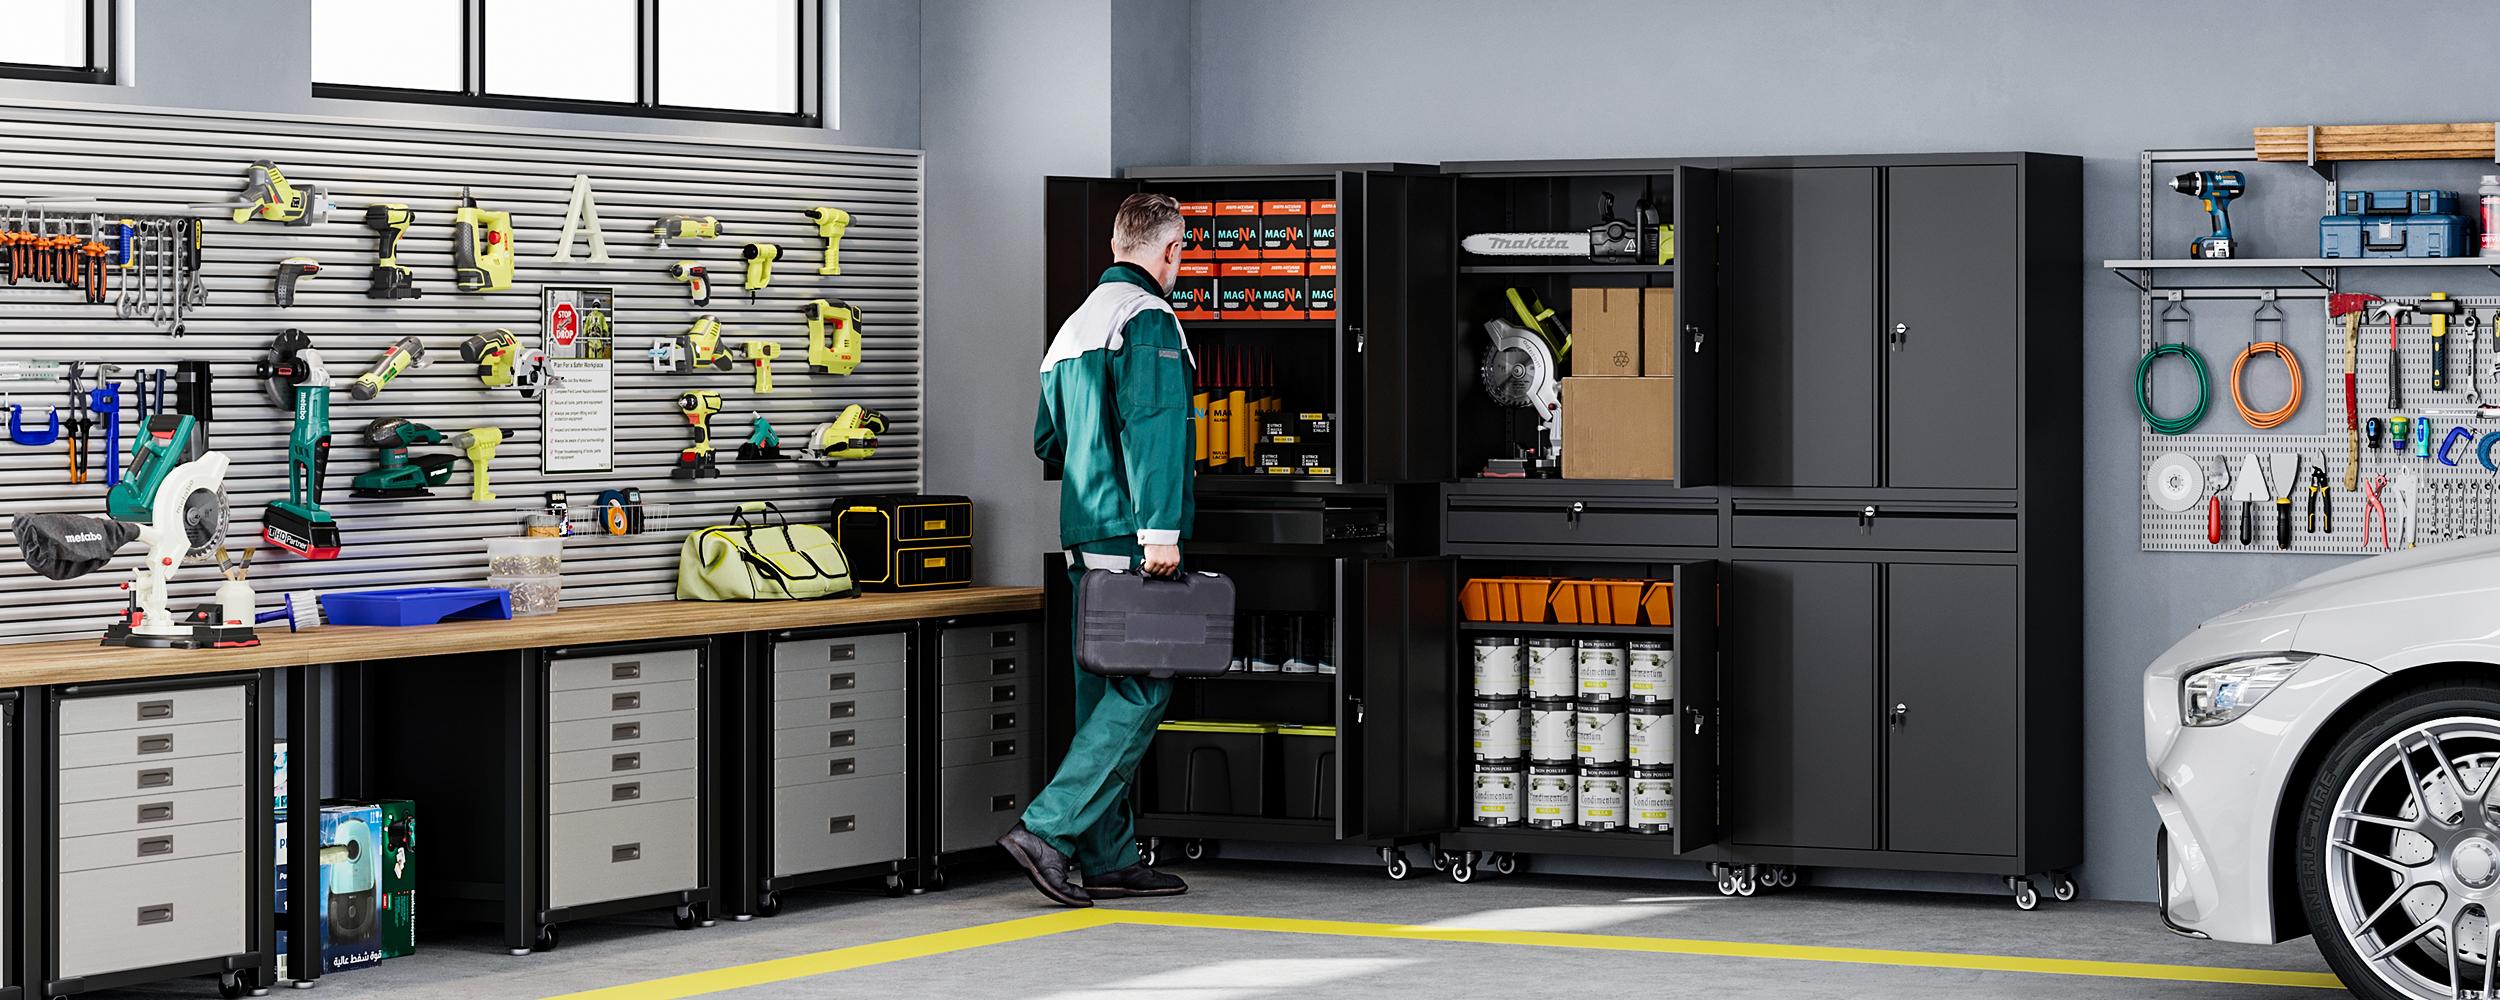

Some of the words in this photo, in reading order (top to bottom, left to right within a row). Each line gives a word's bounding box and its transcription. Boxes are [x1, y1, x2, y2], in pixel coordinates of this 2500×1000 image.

[551, 174, 610, 264] A
[1183, 227, 1210, 242] AGNA
[1217, 227, 1257, 242] MAGNA
[1264, 226, 1304, 241] MAGNA
[1313, 226, 1336, 241] MAG
[1172, 288, 1211, 303] MAGNA
[1223, 288, 1262, 303] MAGNA
[1263, 287, 1302, 302] MAGNA
[1312, 287, 1336, 302] MAG
[558, 310, 572, 319] STOP
[556, 329, 574, 339] DROP
[64, 531, 103, 543] metabo
[286, 534, 308, 550] Partner
[1581, 795, 1621, 805] Condimentum
[2307, 773, 2338, 824] TIRE
[333, 955, 350, 968] عالية
[350, 951, 370, 964] شفط
[369, 949, 382, 962] قوة
